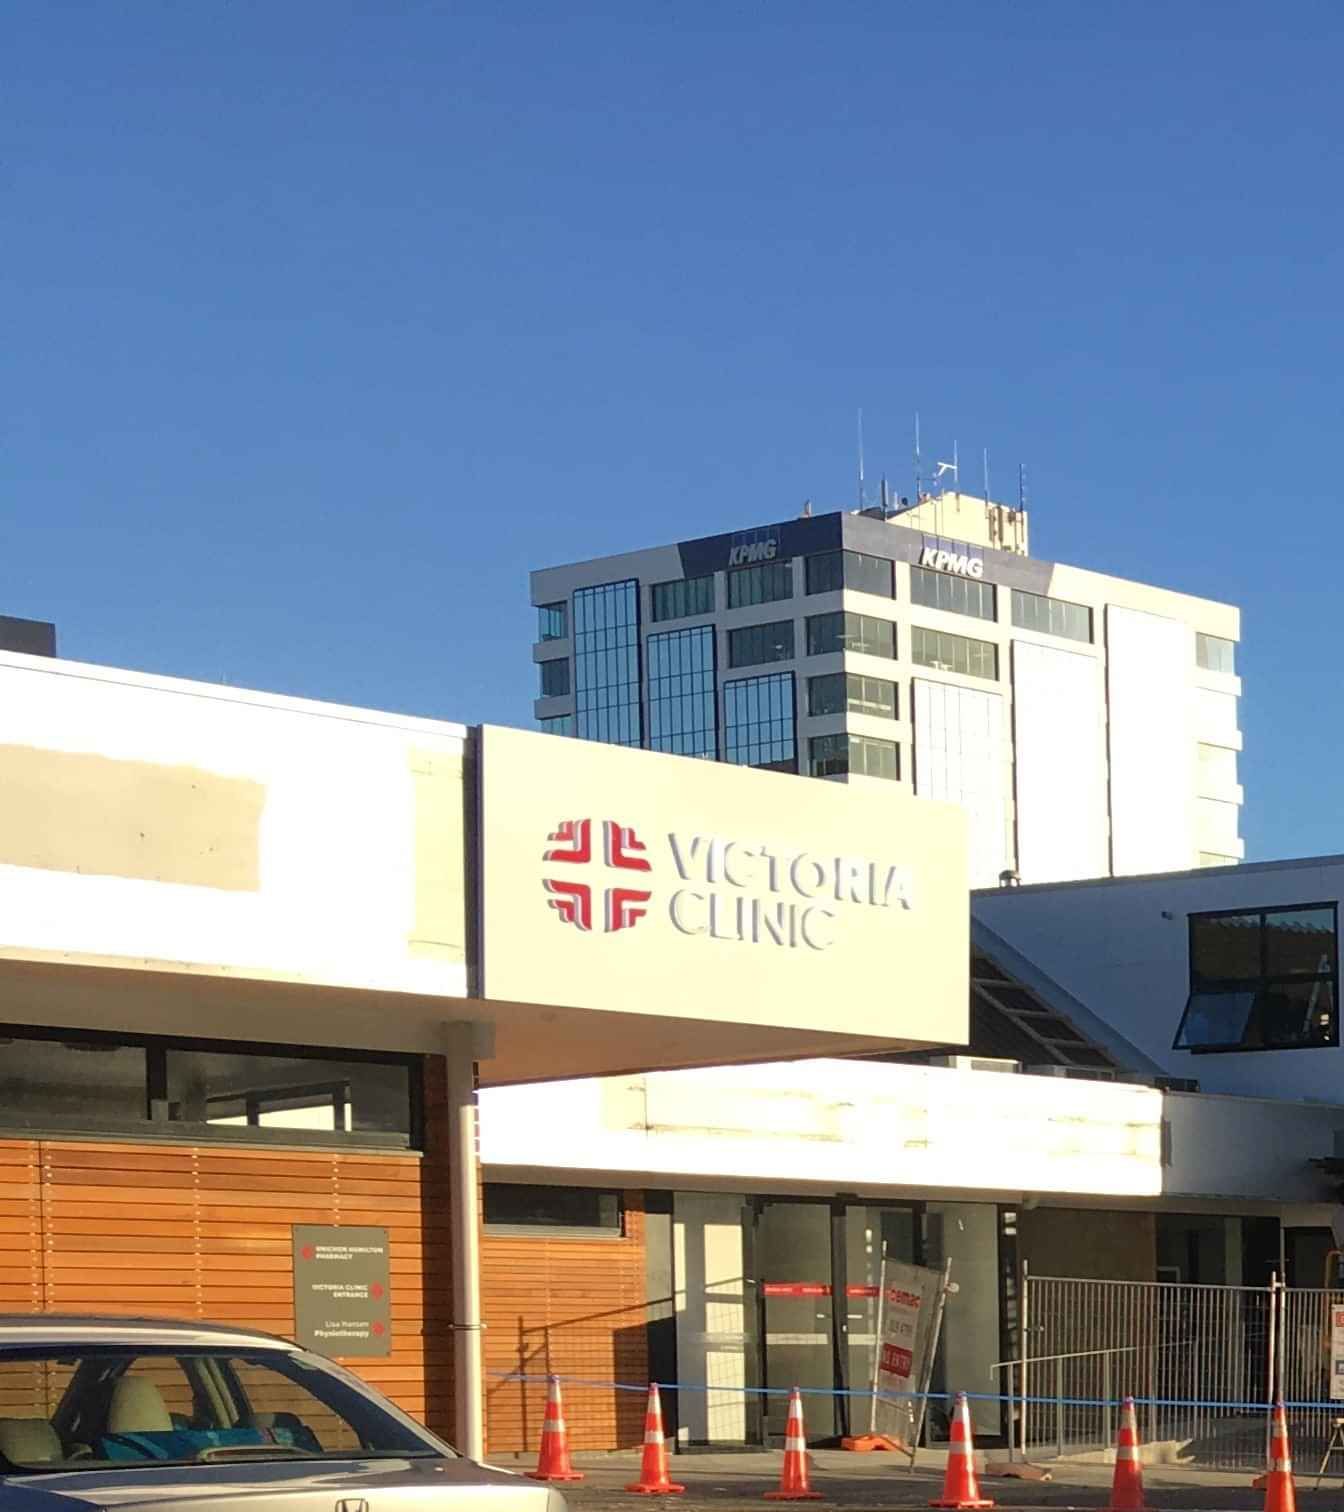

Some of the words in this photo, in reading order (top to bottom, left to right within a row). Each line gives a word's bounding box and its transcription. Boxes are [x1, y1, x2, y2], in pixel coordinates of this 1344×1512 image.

[729, 540, 777, 566] KPMG
[921, 547, 984, 578] KPMG
[667, 832, 911, 911] VICTORIA
[668, 888, 835, 952] CLINIC
[333, 1291, 369, 1299] ENTRANCE
[345, 1284, 369, 1292] CLINIC
